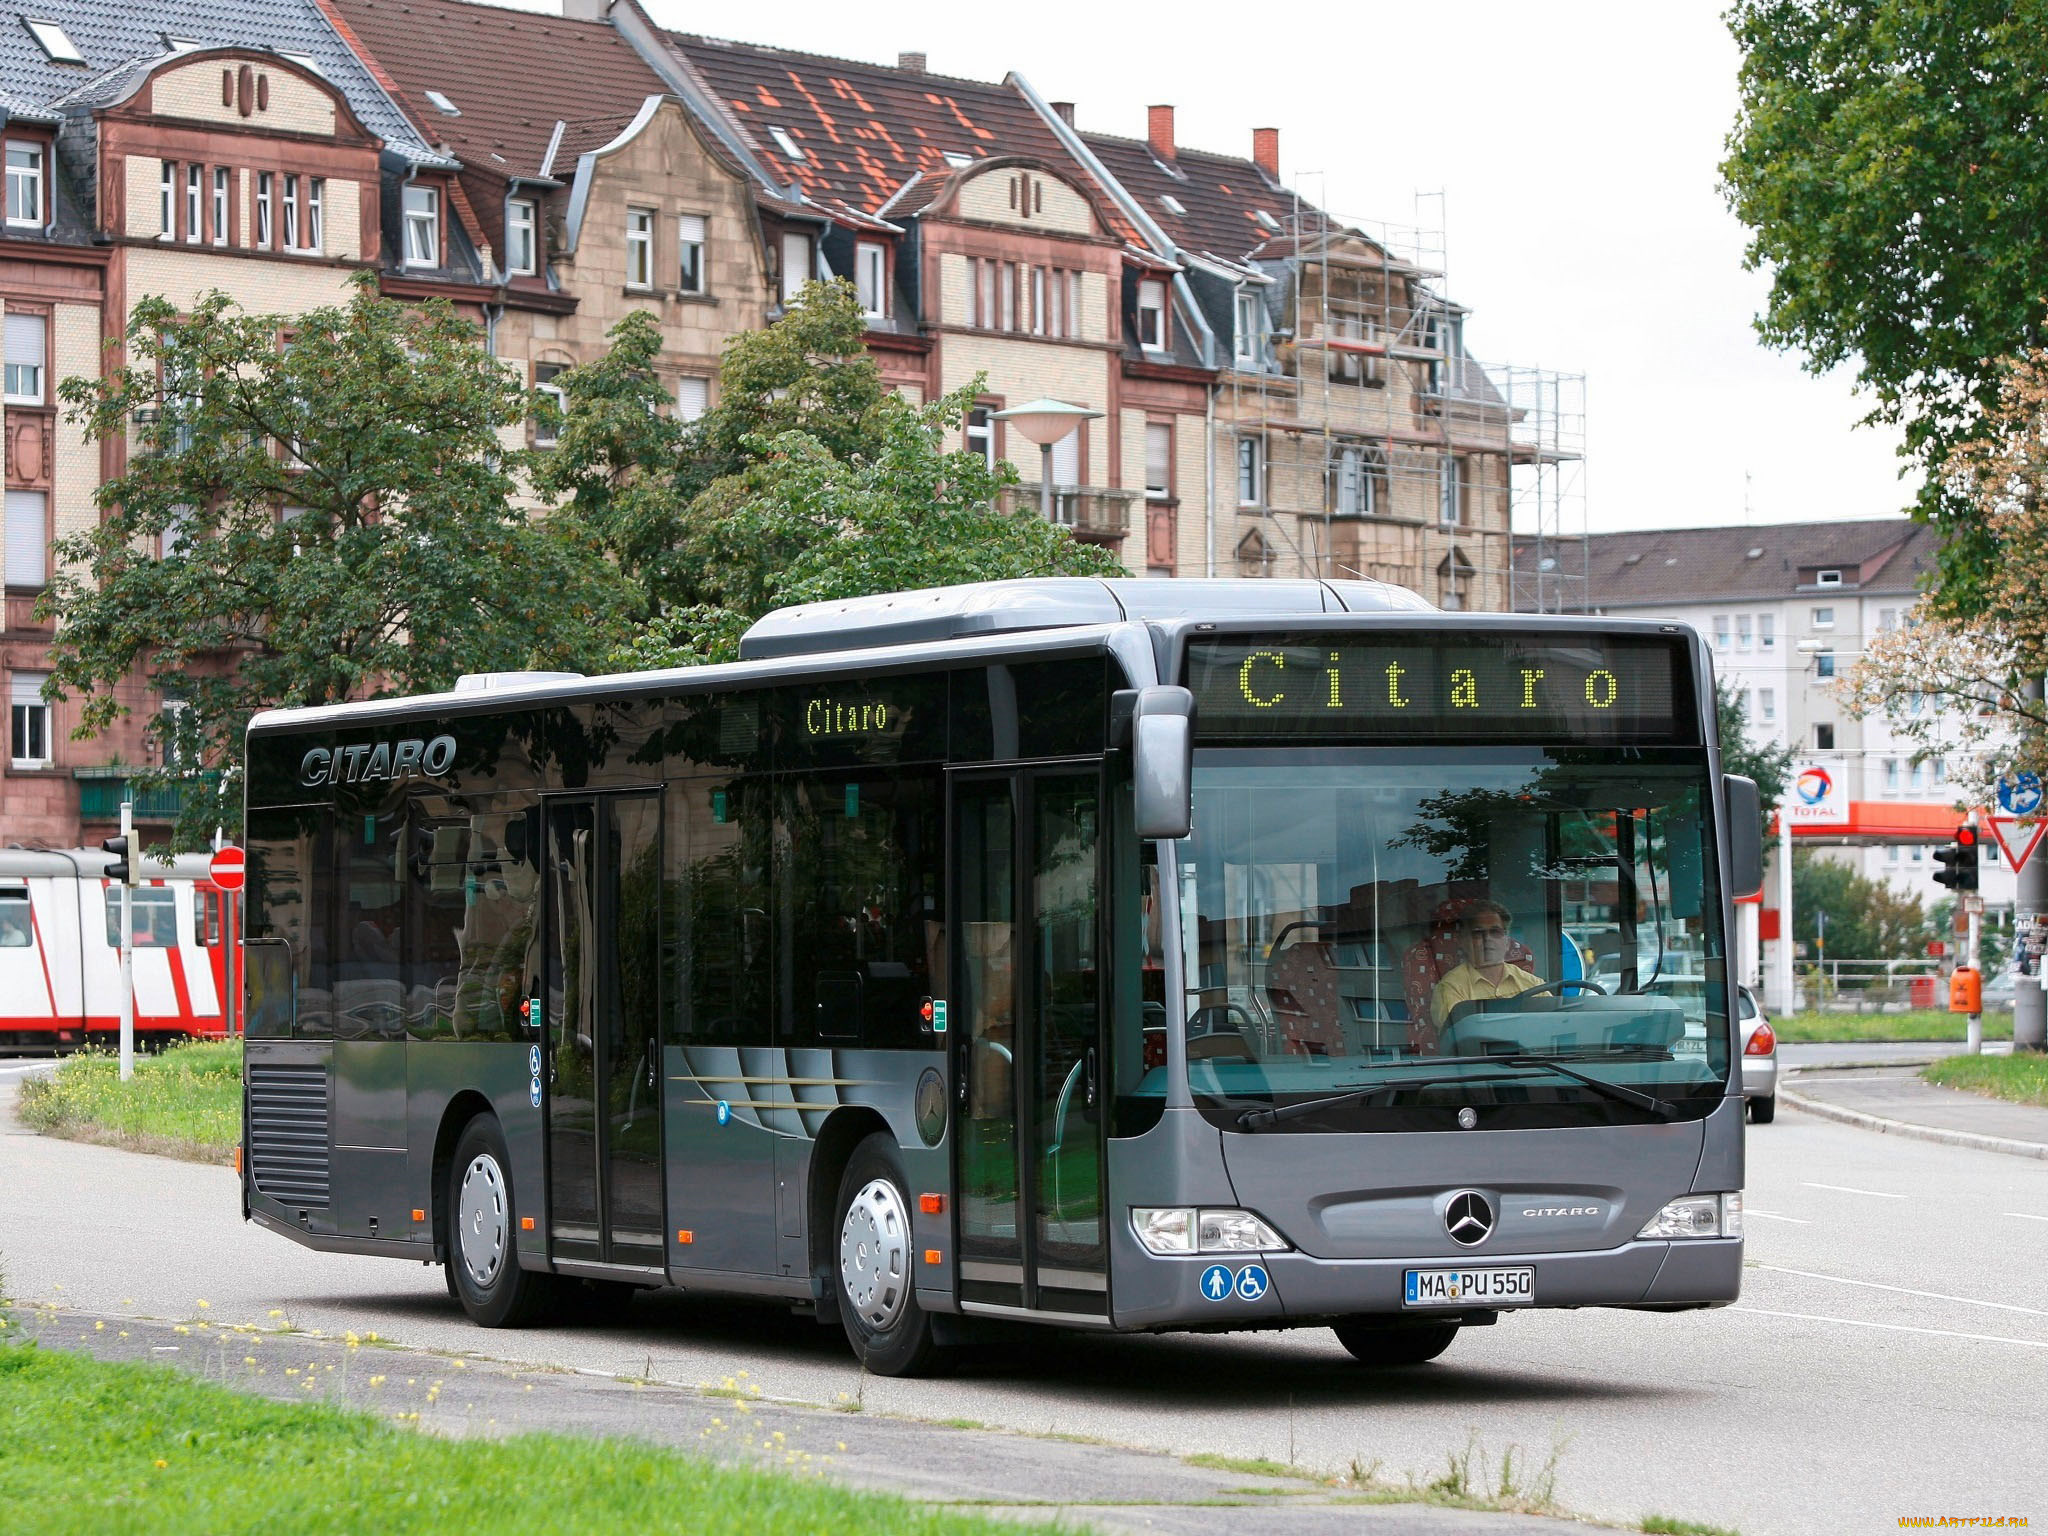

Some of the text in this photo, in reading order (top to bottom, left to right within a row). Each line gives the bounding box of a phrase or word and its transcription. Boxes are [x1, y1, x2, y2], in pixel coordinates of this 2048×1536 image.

[1239, 651, 1617, 708] Citaro
[807, 699, 886, 734] Citaro
[301, 734, 457, 787] CITARO
[1792, 806, 1837, 816] TOTAL
[1522, 1207, 1600, 1217] CITARO
[1420, 1275, 1446, 1297] MA
[1462, 1273, 1488, 1296] PU
[1493, 1272, 1530, 1295] 550
